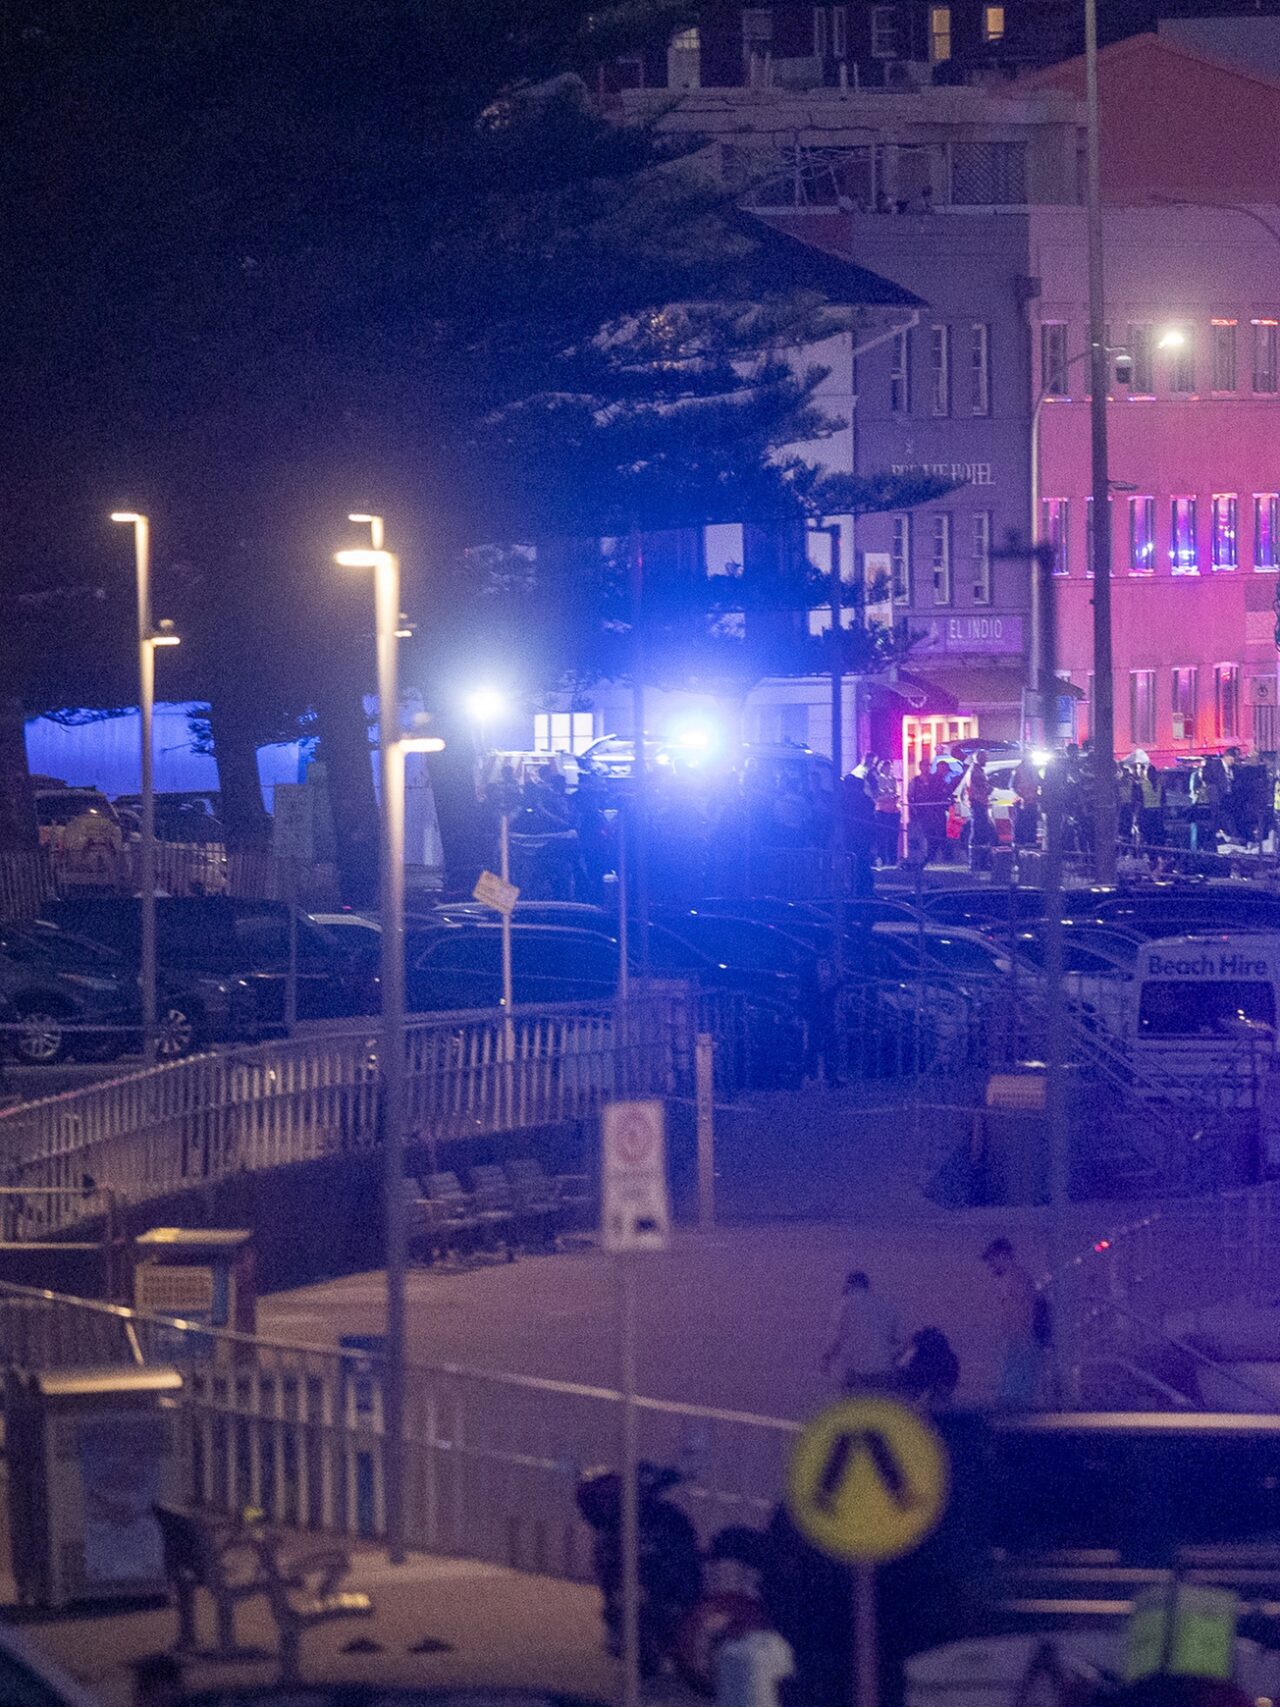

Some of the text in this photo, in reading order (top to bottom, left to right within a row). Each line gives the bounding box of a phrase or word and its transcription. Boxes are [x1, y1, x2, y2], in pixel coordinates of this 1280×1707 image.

[950, 619, 1002, 639] EL INDIO
[1149, 954, 1268, 976] Beach Hire
